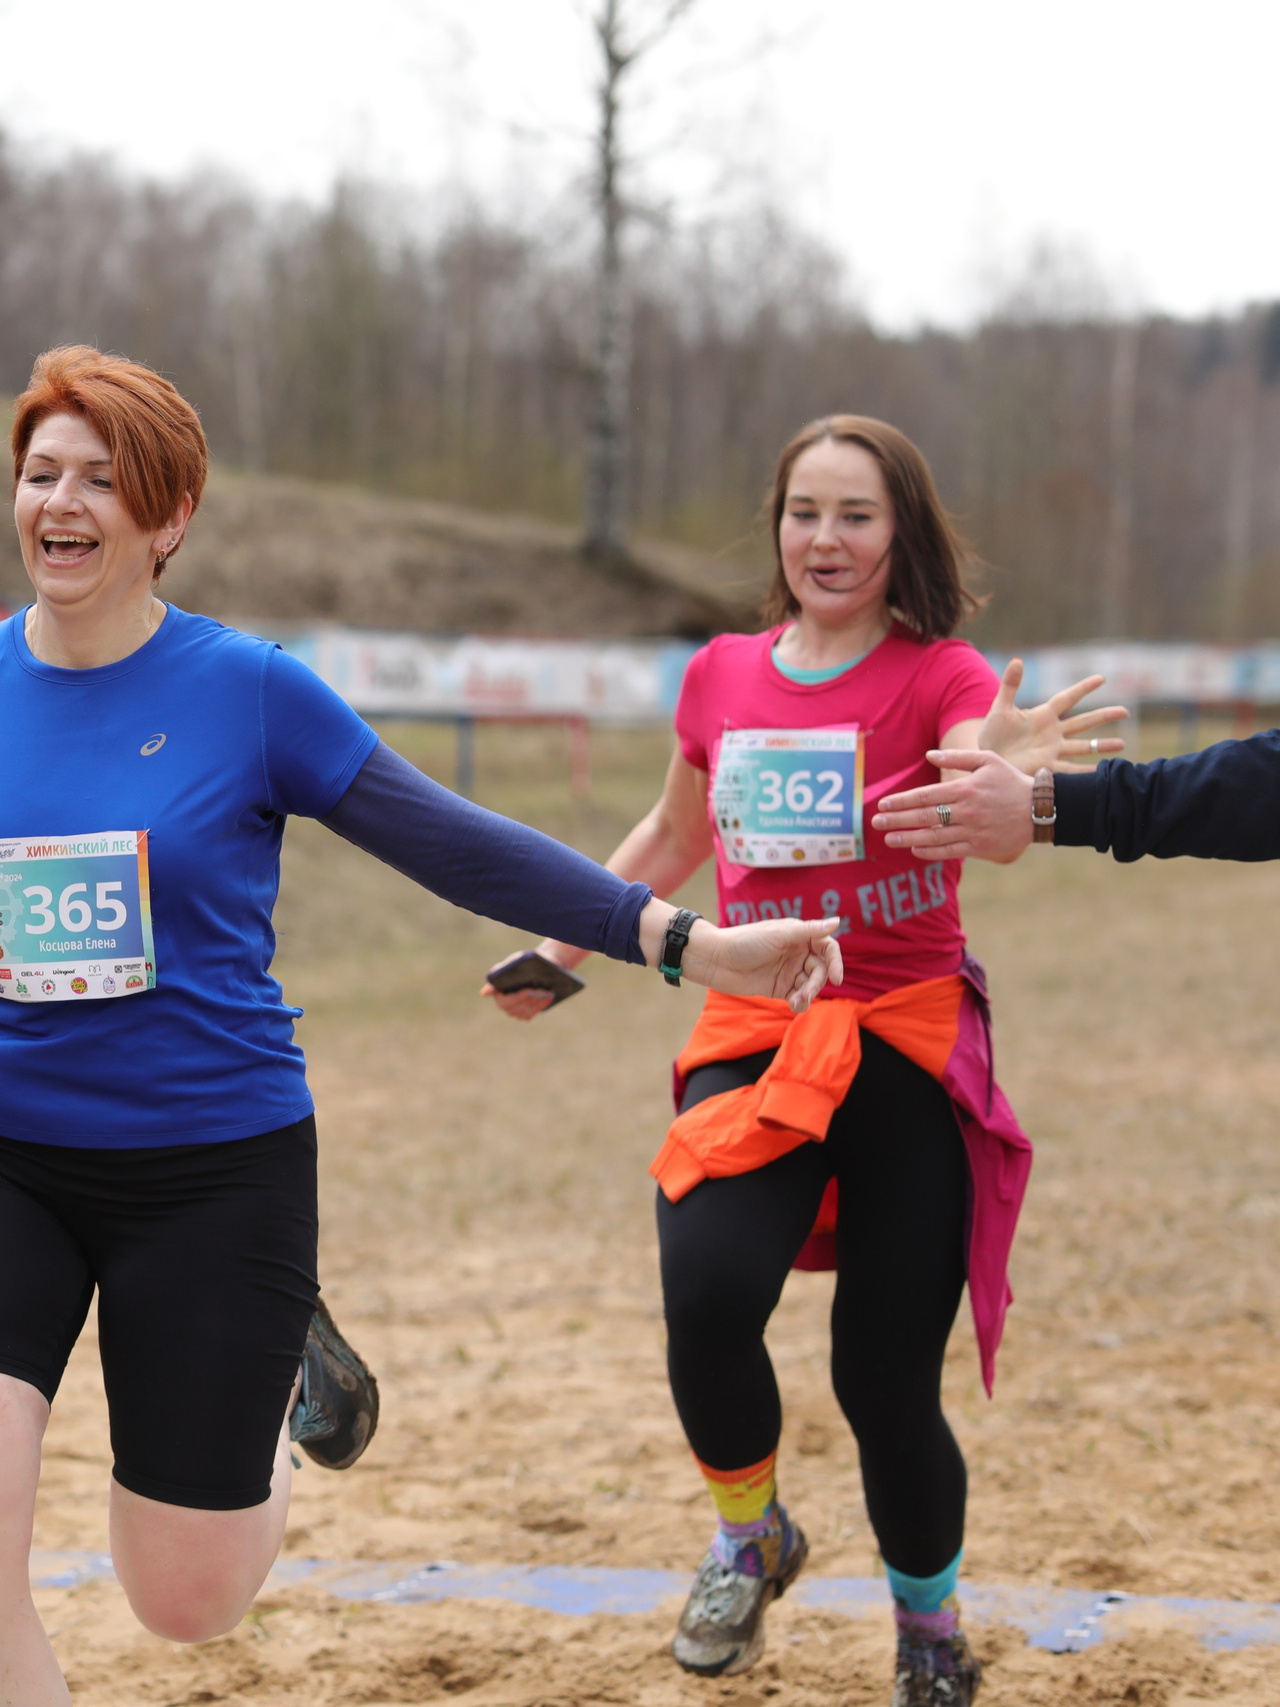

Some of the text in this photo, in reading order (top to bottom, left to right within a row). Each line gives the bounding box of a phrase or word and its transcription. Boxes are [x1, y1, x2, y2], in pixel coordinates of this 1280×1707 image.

[757, 770, 844, 813] 362
[26, 839, 133, 858] ХИМКИНСКИЙ ЛЕС
[4, 873, 23, 882] 2024
[22, 881, 127, 935] 365
[856, 861, 947, 928] FIELD
[39, 938, 117, 954] Косцова Елена
